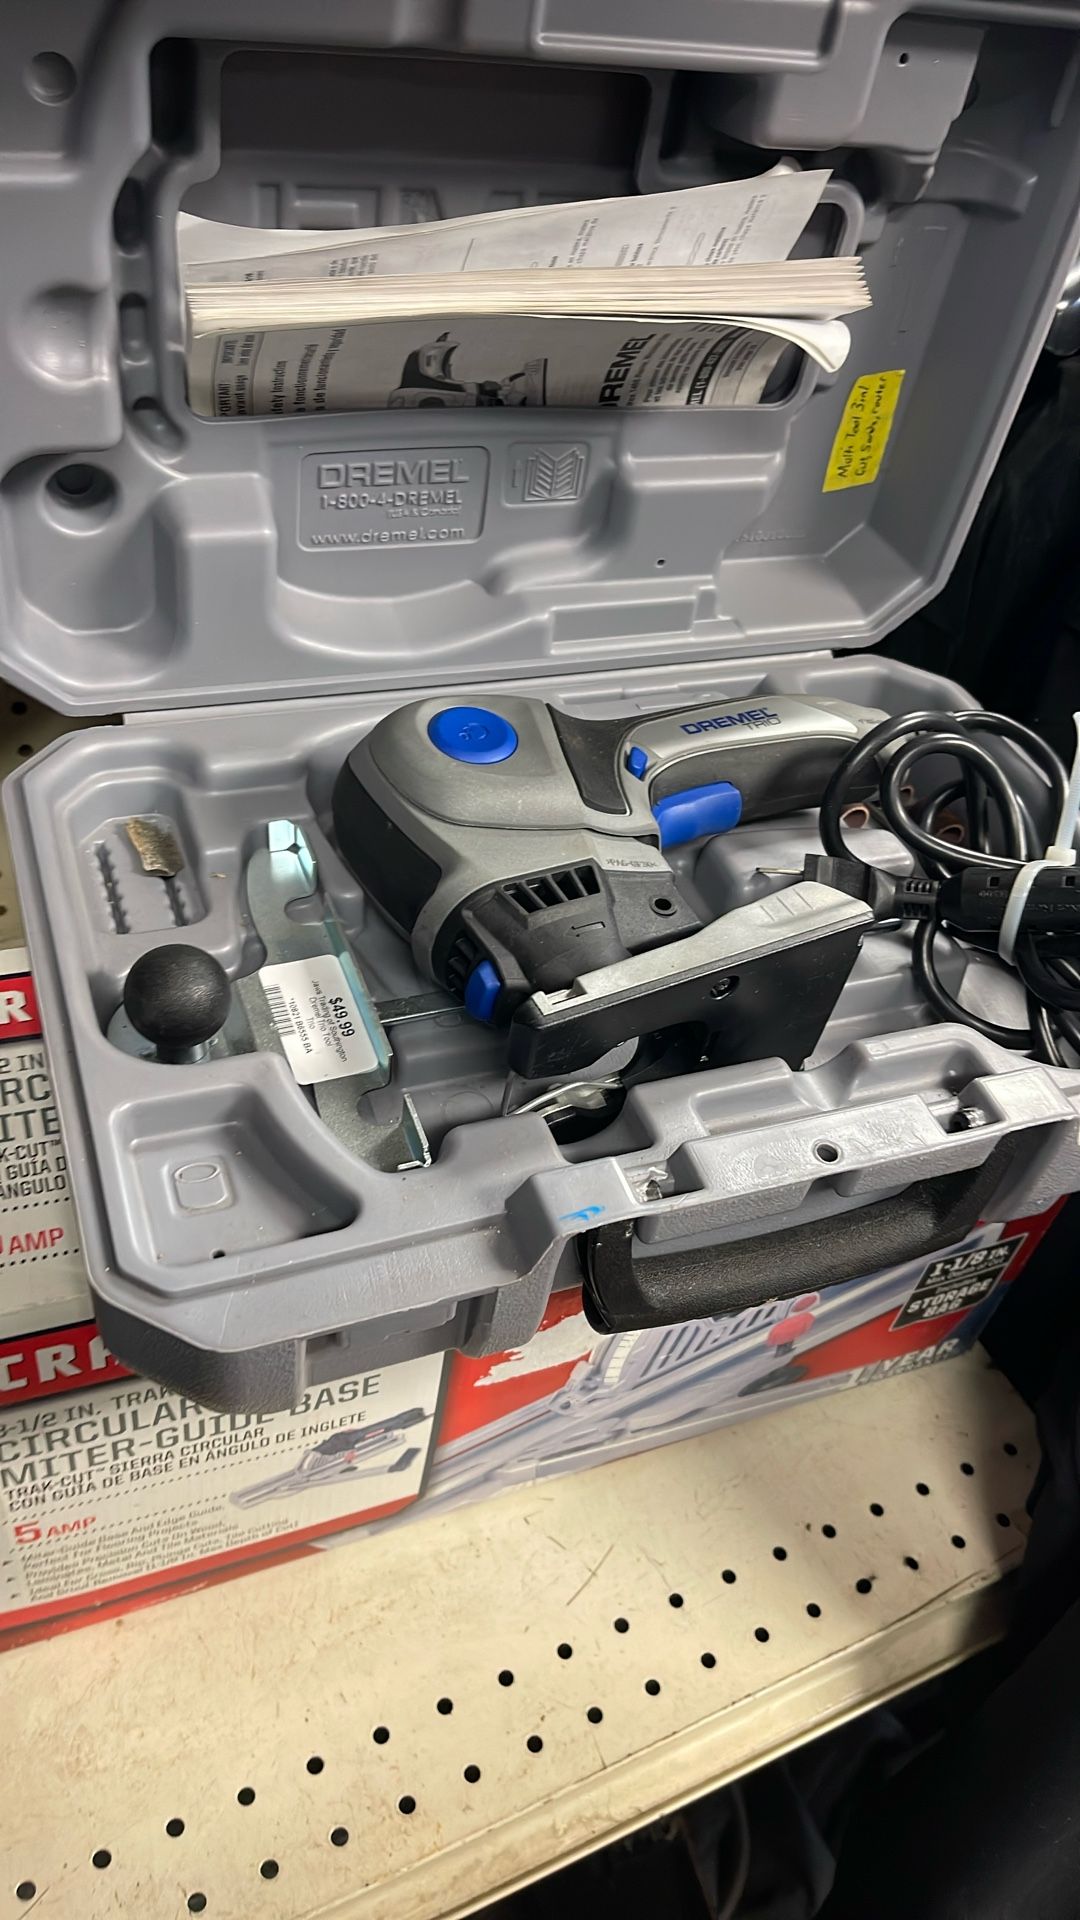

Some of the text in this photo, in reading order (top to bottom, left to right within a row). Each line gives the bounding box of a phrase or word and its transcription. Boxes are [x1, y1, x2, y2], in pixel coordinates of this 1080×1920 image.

[318, 459, 470, 489] DREMEL
[321, 490, 463, 509] 1-800-4-DREMEL
[311, 527, 465, 545] www.dremel.com
[680, 708, 777, 734] DREMEL
[741, 717, 782, 731] TRIO
[306, 1017, 316, 1030] Trio
[309, 996, 335, 1047] Dremel Trio Tool
[328, 997, 355, 1037] $49.99
[9, 1227, 64, 1255] AMP
[907, 1277, 993, 1313] STORAGE
[922, 1298, 963, 1317] BAG
[9, 1494, 45, 1512] CON
[102, 1475, 125, 1488] DE
[130, 1461, 174, 1482] BASE
[179, 1455, 199, 1468] EN
[275, 1429, 295, 1444] DE
[300, 1411, 367, 1437] INGLETE
[110, 1450, 174, 1475] SIERRA
[181, 1427, 264, 1457] CIRCULAR
[14, 1516, 97, 1544] 5 AMP
